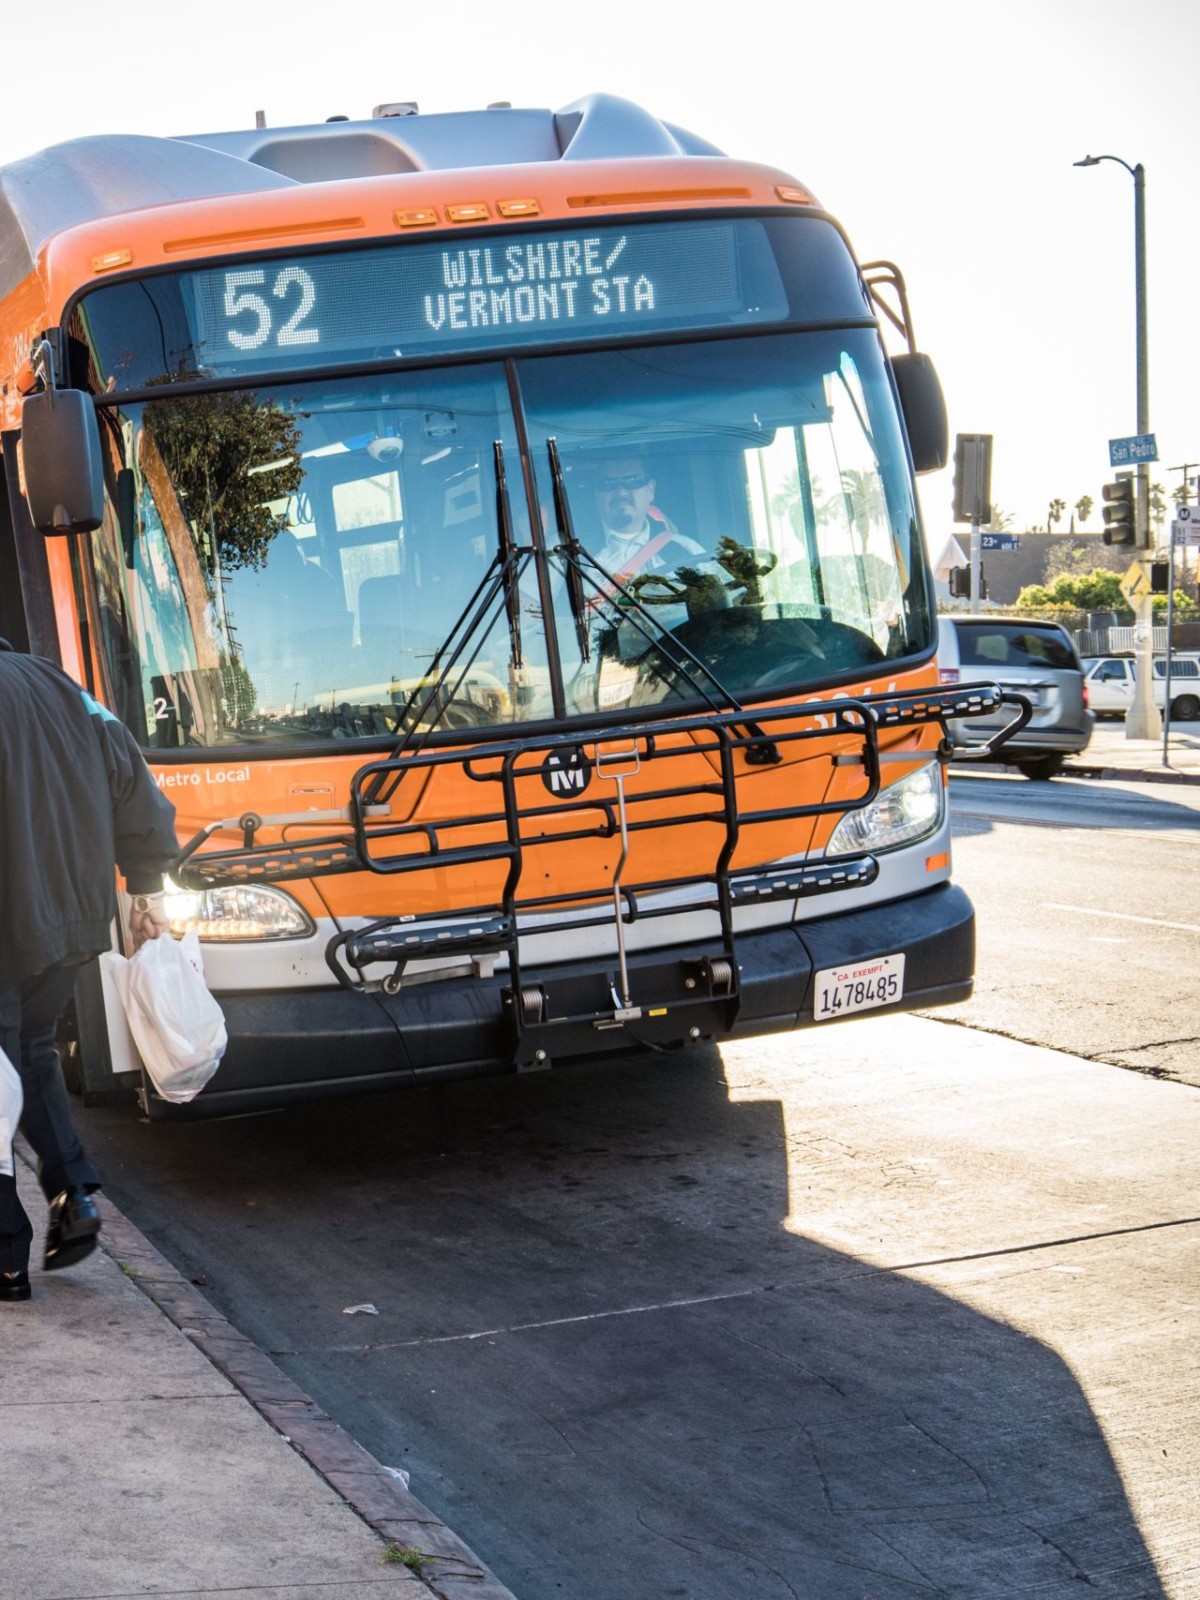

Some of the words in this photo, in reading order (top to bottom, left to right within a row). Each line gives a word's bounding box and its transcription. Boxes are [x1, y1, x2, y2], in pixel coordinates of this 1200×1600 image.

[441, 236, 627, 288] WILSHIRE/
[223, 266, 320, 350] 52
[424, 283, 577, 330] VERMONT
[592, 274, 655, 315] STA
[1112, 445, 1128, 460] San
[1130, 443, 1156, 457] Pedro
[152, 771, 200, 788] Metro
[206, 765, 250, 784] Local
[821, 973, 898, 1013] 1478485
[838, 974, 849, 982] CA
[852, 965, 884, 979] EXEMPT
